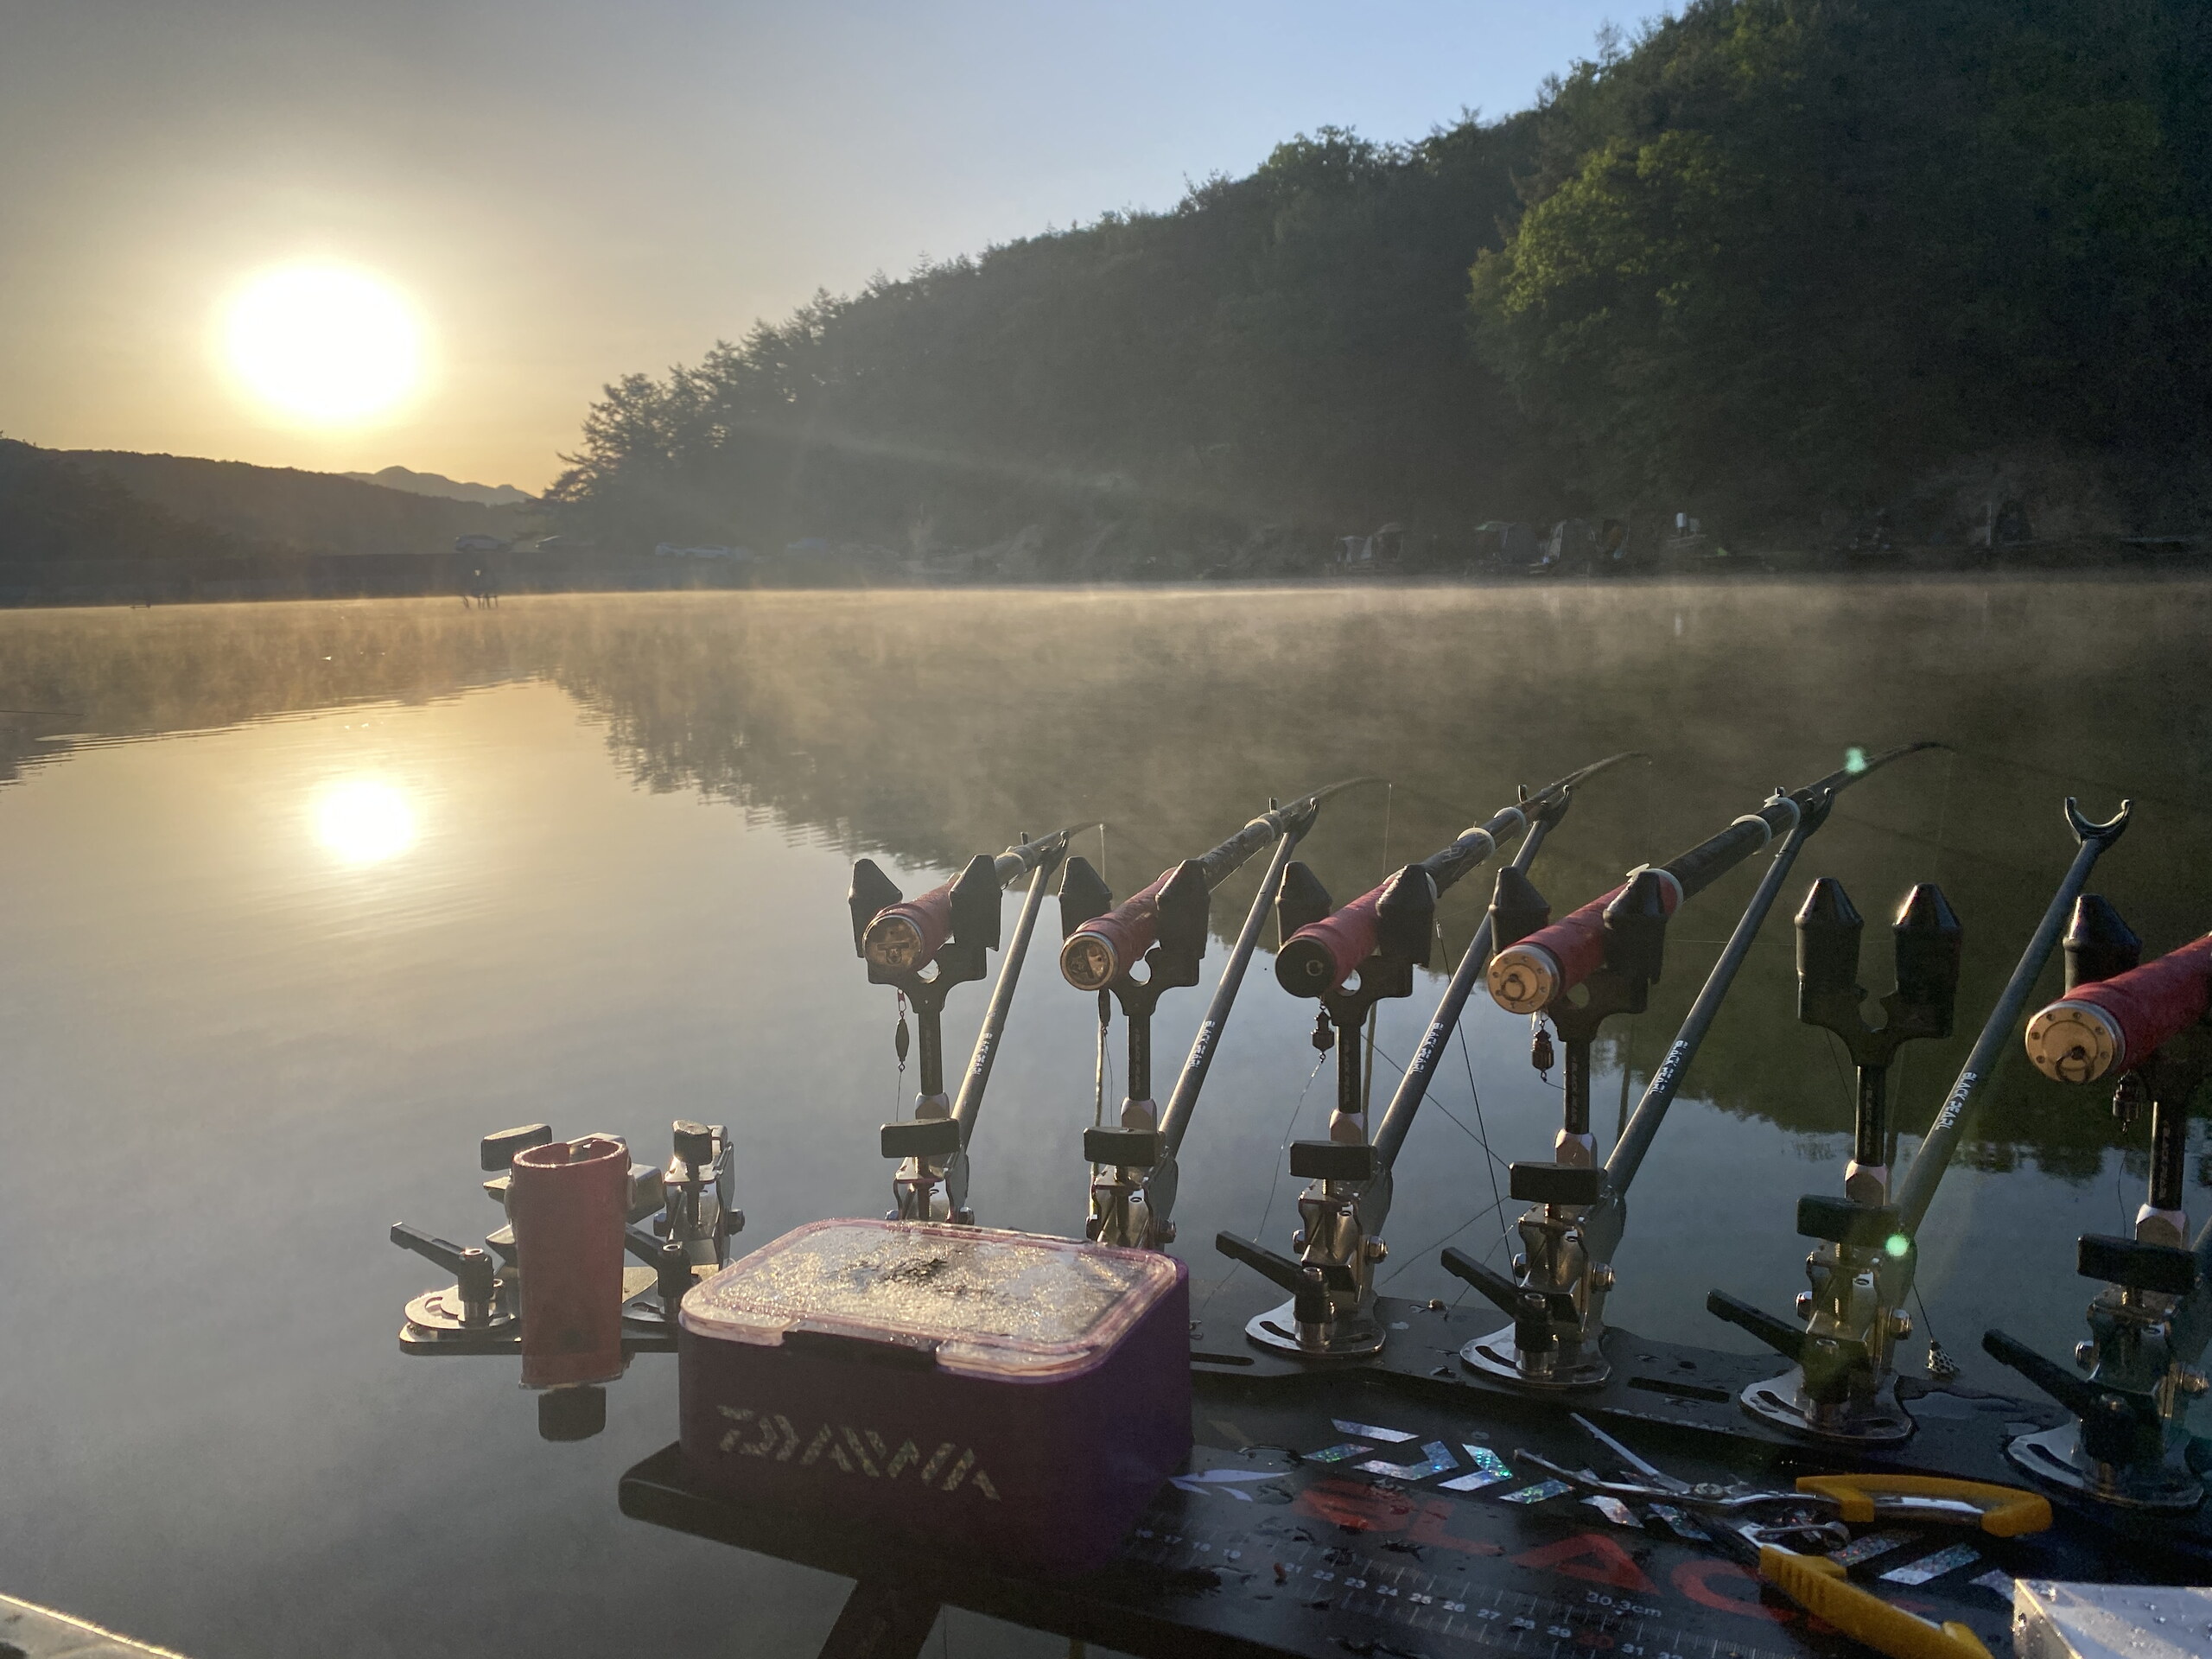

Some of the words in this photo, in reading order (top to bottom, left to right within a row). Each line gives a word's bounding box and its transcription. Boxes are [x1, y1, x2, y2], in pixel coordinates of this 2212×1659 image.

[1198, 1020, 1216, 1044] BLACK
[1422, 1023, 1444, 1047] BLACK
[1188, 1044, 1206, 1069] PEARL
[1410, 1047, 1433, 1074] PEARL
[1664, 1039, 1688, 1067] BLACK
[1649, 1066, 1675, 1095] PEARL
[1951, 1072, 1978, 1101] BLACK
[1935, 1100, 1963, 1130] PEARL
[717, 1404, 1001, 1502] DAIWA
[1313, 1569, 1335, 1582] 22
[1344, 1576, 1367, 1589] 23
[1376, 1584, 1399, 1597] 24
[1408, 1592, 1433, 1605] 25
[1442, 1600, 1466, 1613] 26
[1477, 1608, 1502, 1620] 27
[1510, 1617, 1535, 1630] 28
[1547, 1625, 1572, 1638] 29
[1620, 1643, 1644, 1656] 31
[1586, 1590, 1662, 1618] 30.3cm
